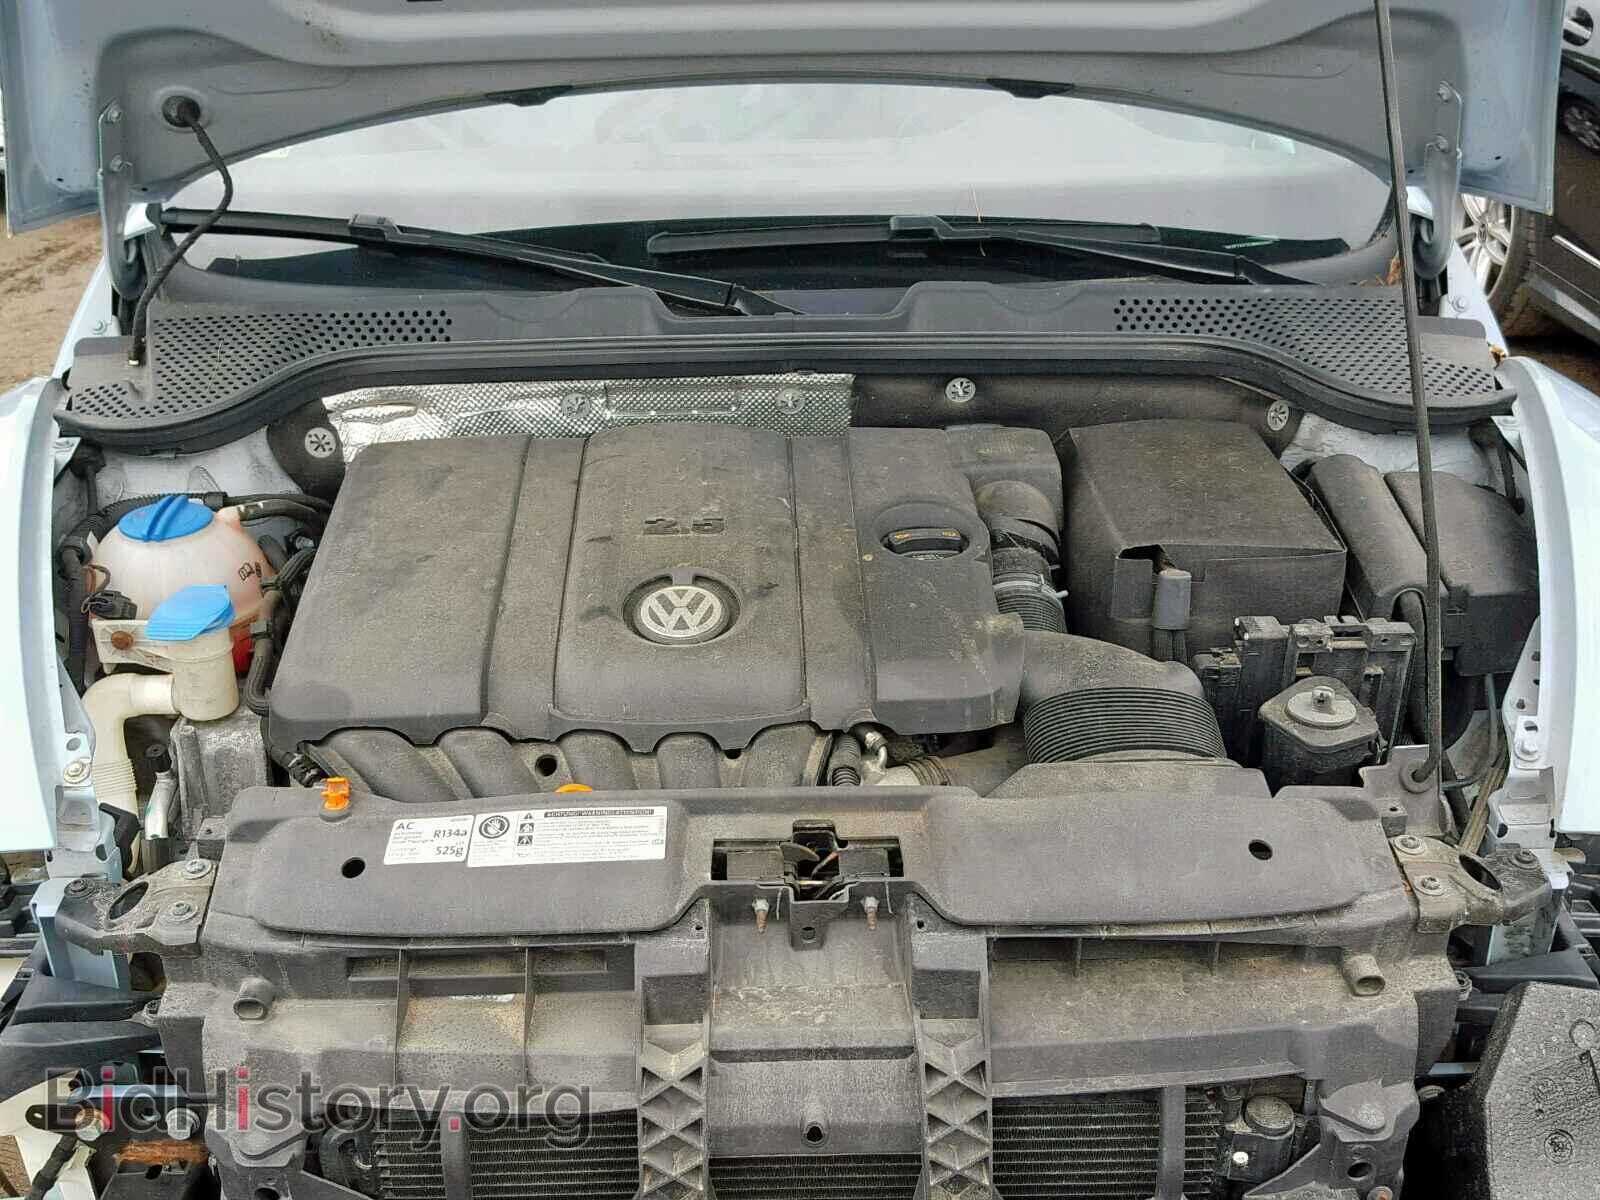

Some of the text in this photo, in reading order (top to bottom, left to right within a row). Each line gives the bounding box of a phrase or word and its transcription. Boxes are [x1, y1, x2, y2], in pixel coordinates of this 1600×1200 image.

[643, 517, 726, 535] 2.5
[641, 585, 722, 637] VW
[396, 821, 417, 831] AC
[434, 828, 467, 838] R134a
[436, 845, 464, 858] 525g
